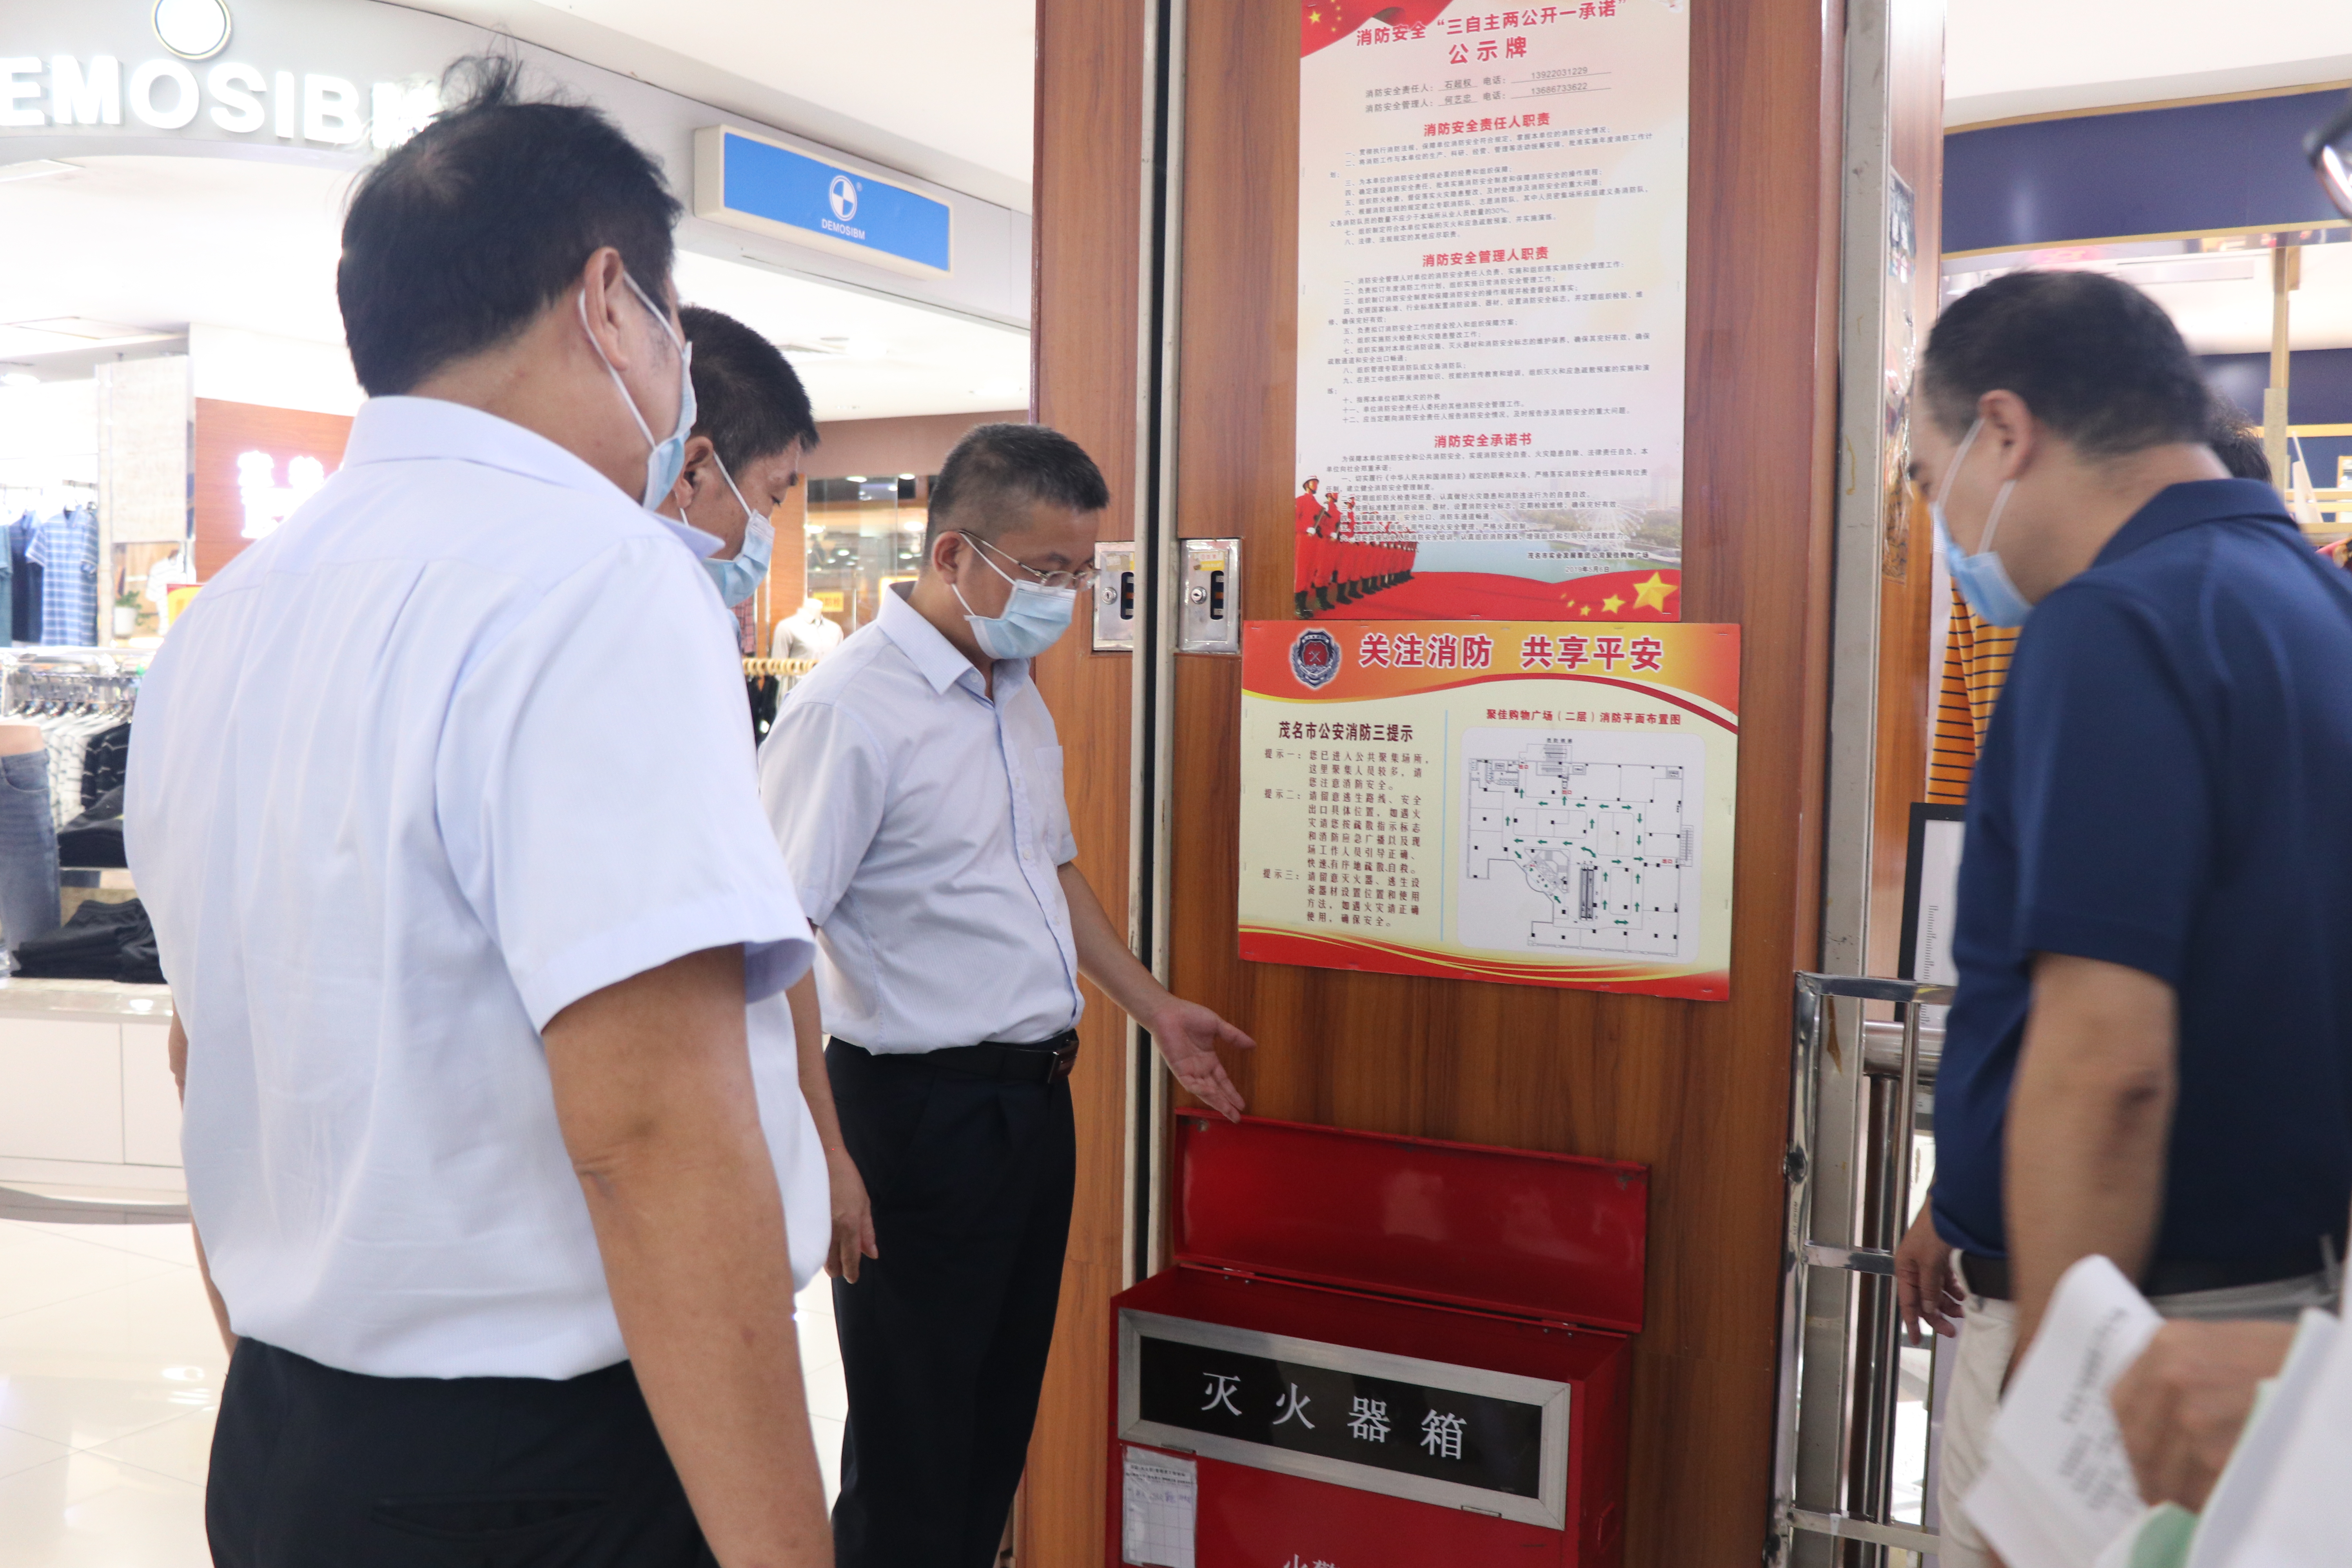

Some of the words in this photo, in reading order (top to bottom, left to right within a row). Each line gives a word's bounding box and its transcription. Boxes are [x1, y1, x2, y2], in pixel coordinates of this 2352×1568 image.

[1449, 36, 1527, 65] 公示牌
[1531, 67, 1588, 80] 13922031229
[1531, 82, 1587, 95] 13686733622
[1424, 112, 1550, 137] 消防安全责任人职责
[821, 218, 866, 240] DEMOSIBM
[1422, 246, 1548, 267] 消防安全管理人职责
[1434, 432, 1532, 448] 消防安全承诺书
[1360, 634, 1492, 668] 关注消防
[1521, 635, 1663, 672] 共享平安
[1486, 709, 1682, 725] 聚佳购物广场（二层）消防平面布置图
[1279, 720, 1412, 742] 茂名市公安消防三提示
[1265, 748, 1301, 760] 提示一：
[1264, 788, 1300, 800] 提示二：
[1263, 868, 1299, 880] 提示三：
[1200, 1371, 1468, 1461] 灭火器箱
